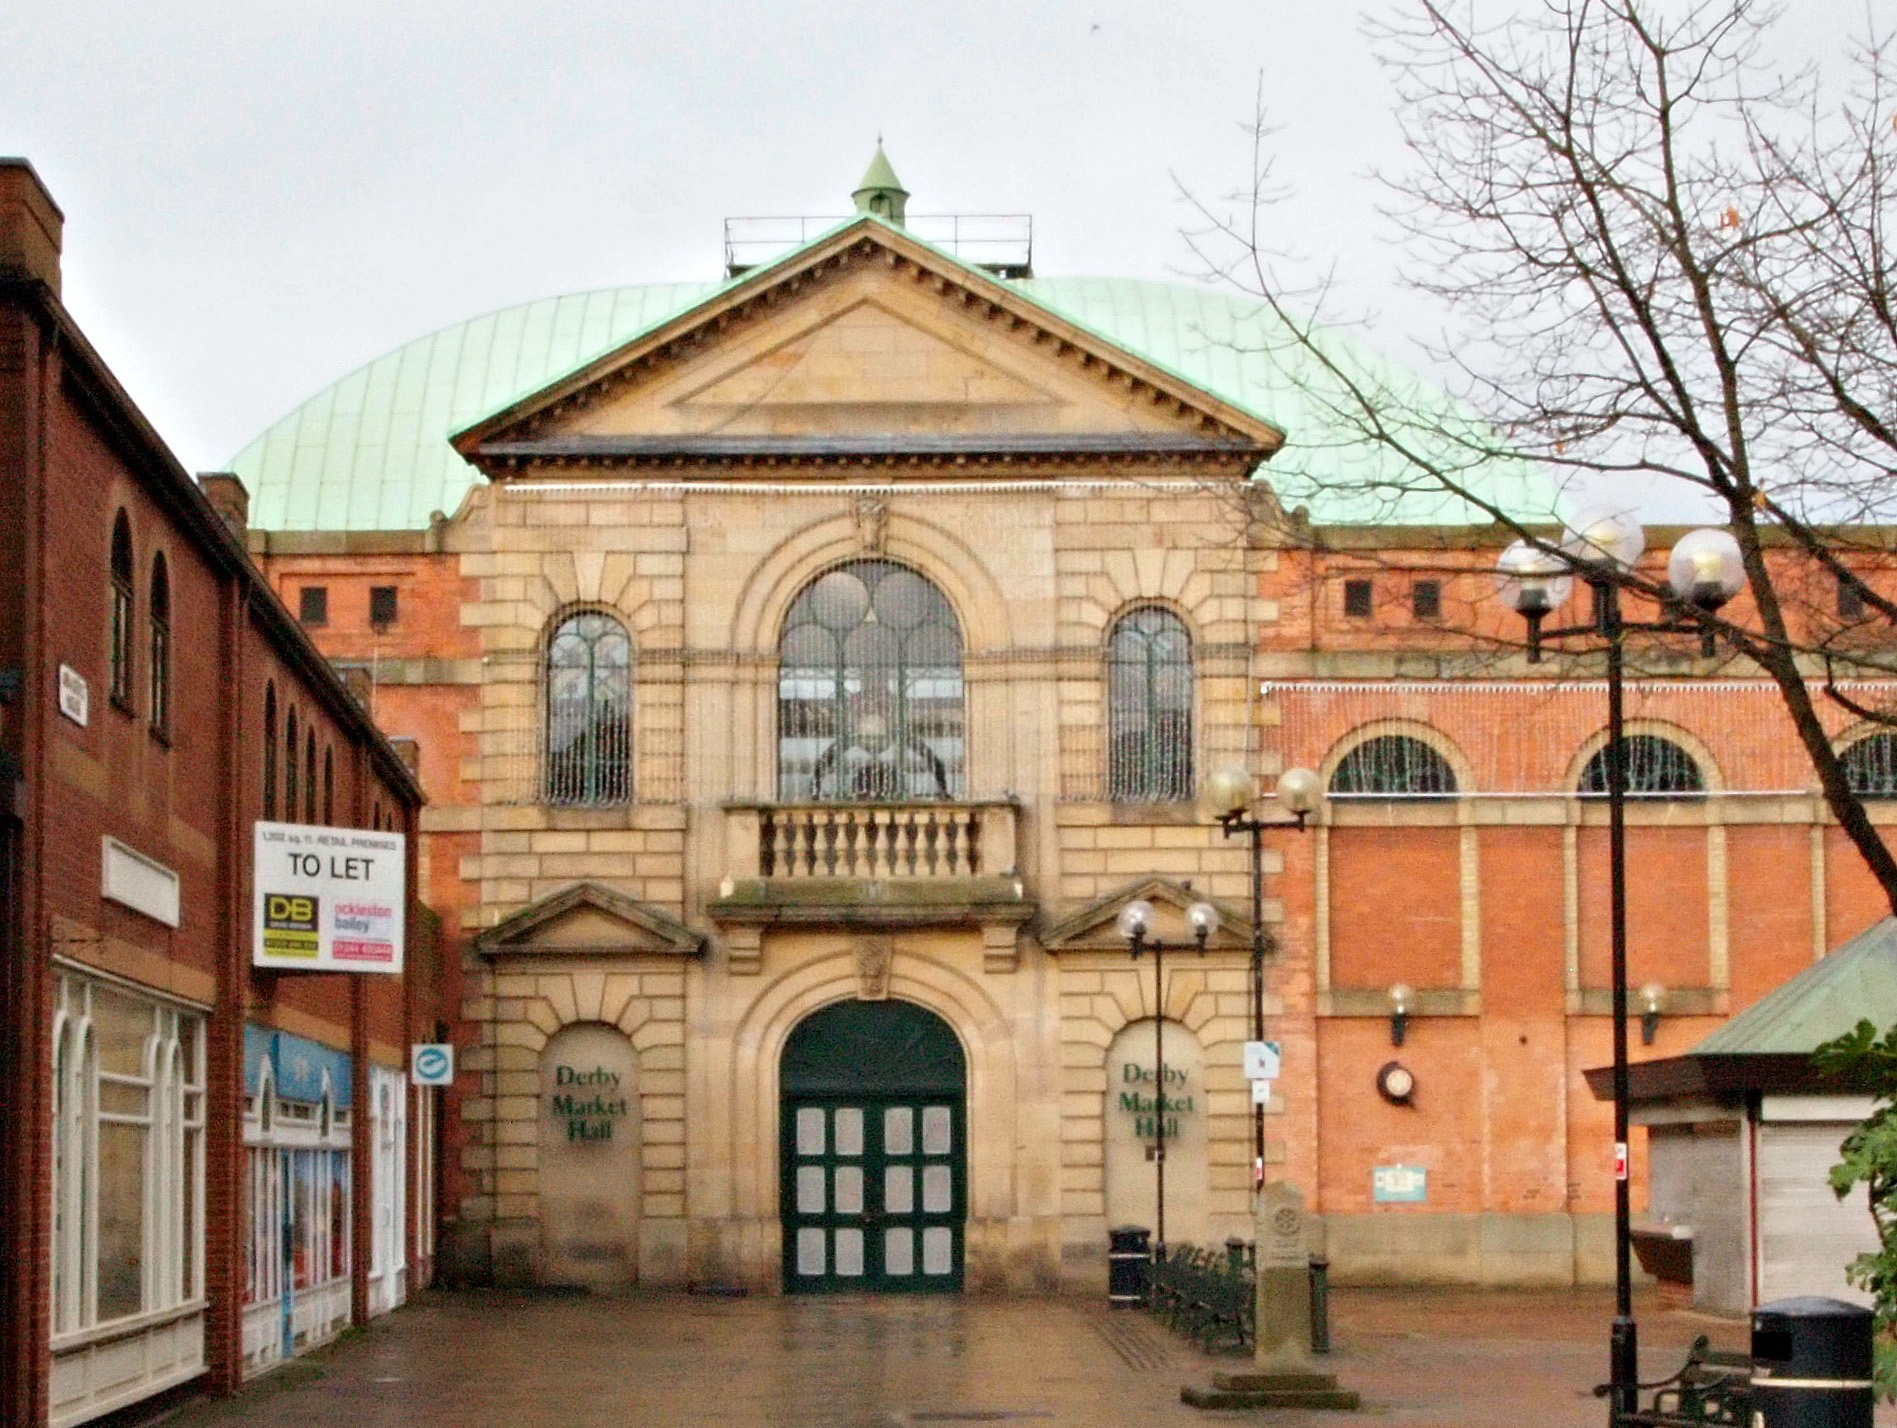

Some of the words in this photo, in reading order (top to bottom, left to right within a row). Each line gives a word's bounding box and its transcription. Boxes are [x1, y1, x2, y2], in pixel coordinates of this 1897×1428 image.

[288, 852, 320, 877] TO
[330, 855, 375, 881] LET
[270, 896, 312, 921] DB
[335, 916, 370, 934] bailey
[556, 1065, 620, 1093] Derby
[1122, 1063, 1189, 1090] Deby
[552, 1094, 627, 1116] Market
[1118, 1090, 1195, 1113] Maket
[567, 1119, 611, 1142] Hall
[1135, 1117, 1179, 1138] Hll
